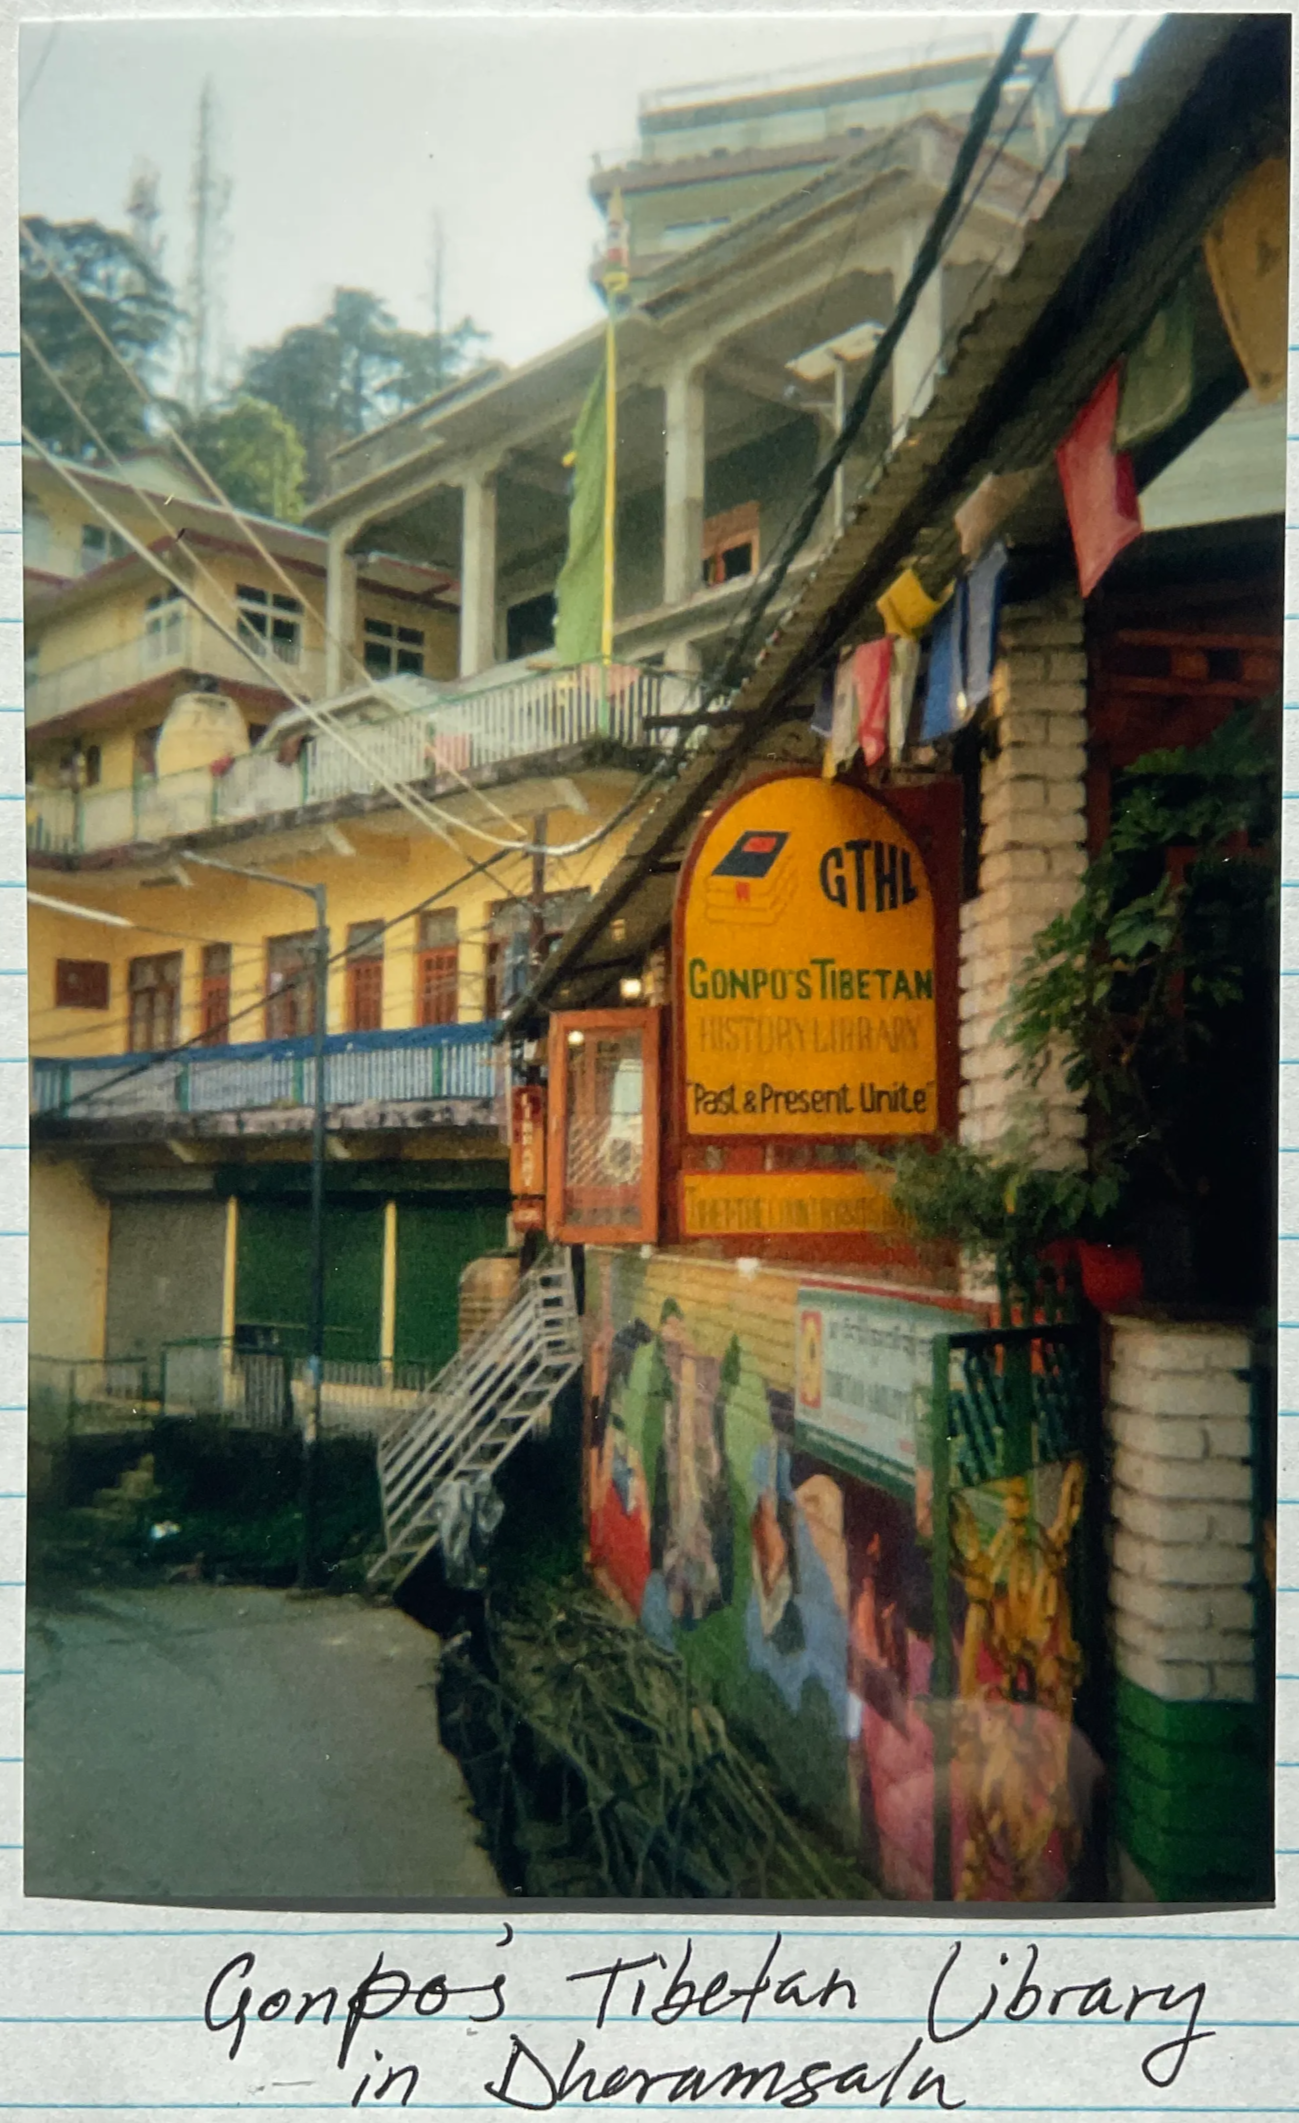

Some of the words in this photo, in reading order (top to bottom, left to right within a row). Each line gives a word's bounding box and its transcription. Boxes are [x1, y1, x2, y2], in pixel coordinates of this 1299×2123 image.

[819, 839, 918, 912] GTHL
[810, 958, 933, 1000] TIBETAN
[701, 1015, 804, 1053] HISTORY
[813, 1015, 919, 1054] LIBRARY
[761, 1082, 854, 1113] Present
[204, 1922, 513, 2069] Gonpo's
[566, 1932, 857, 2028] Tibetan
[928, 1940, 1216, 2087] Library
[351, 2049, 419, 2107] in
